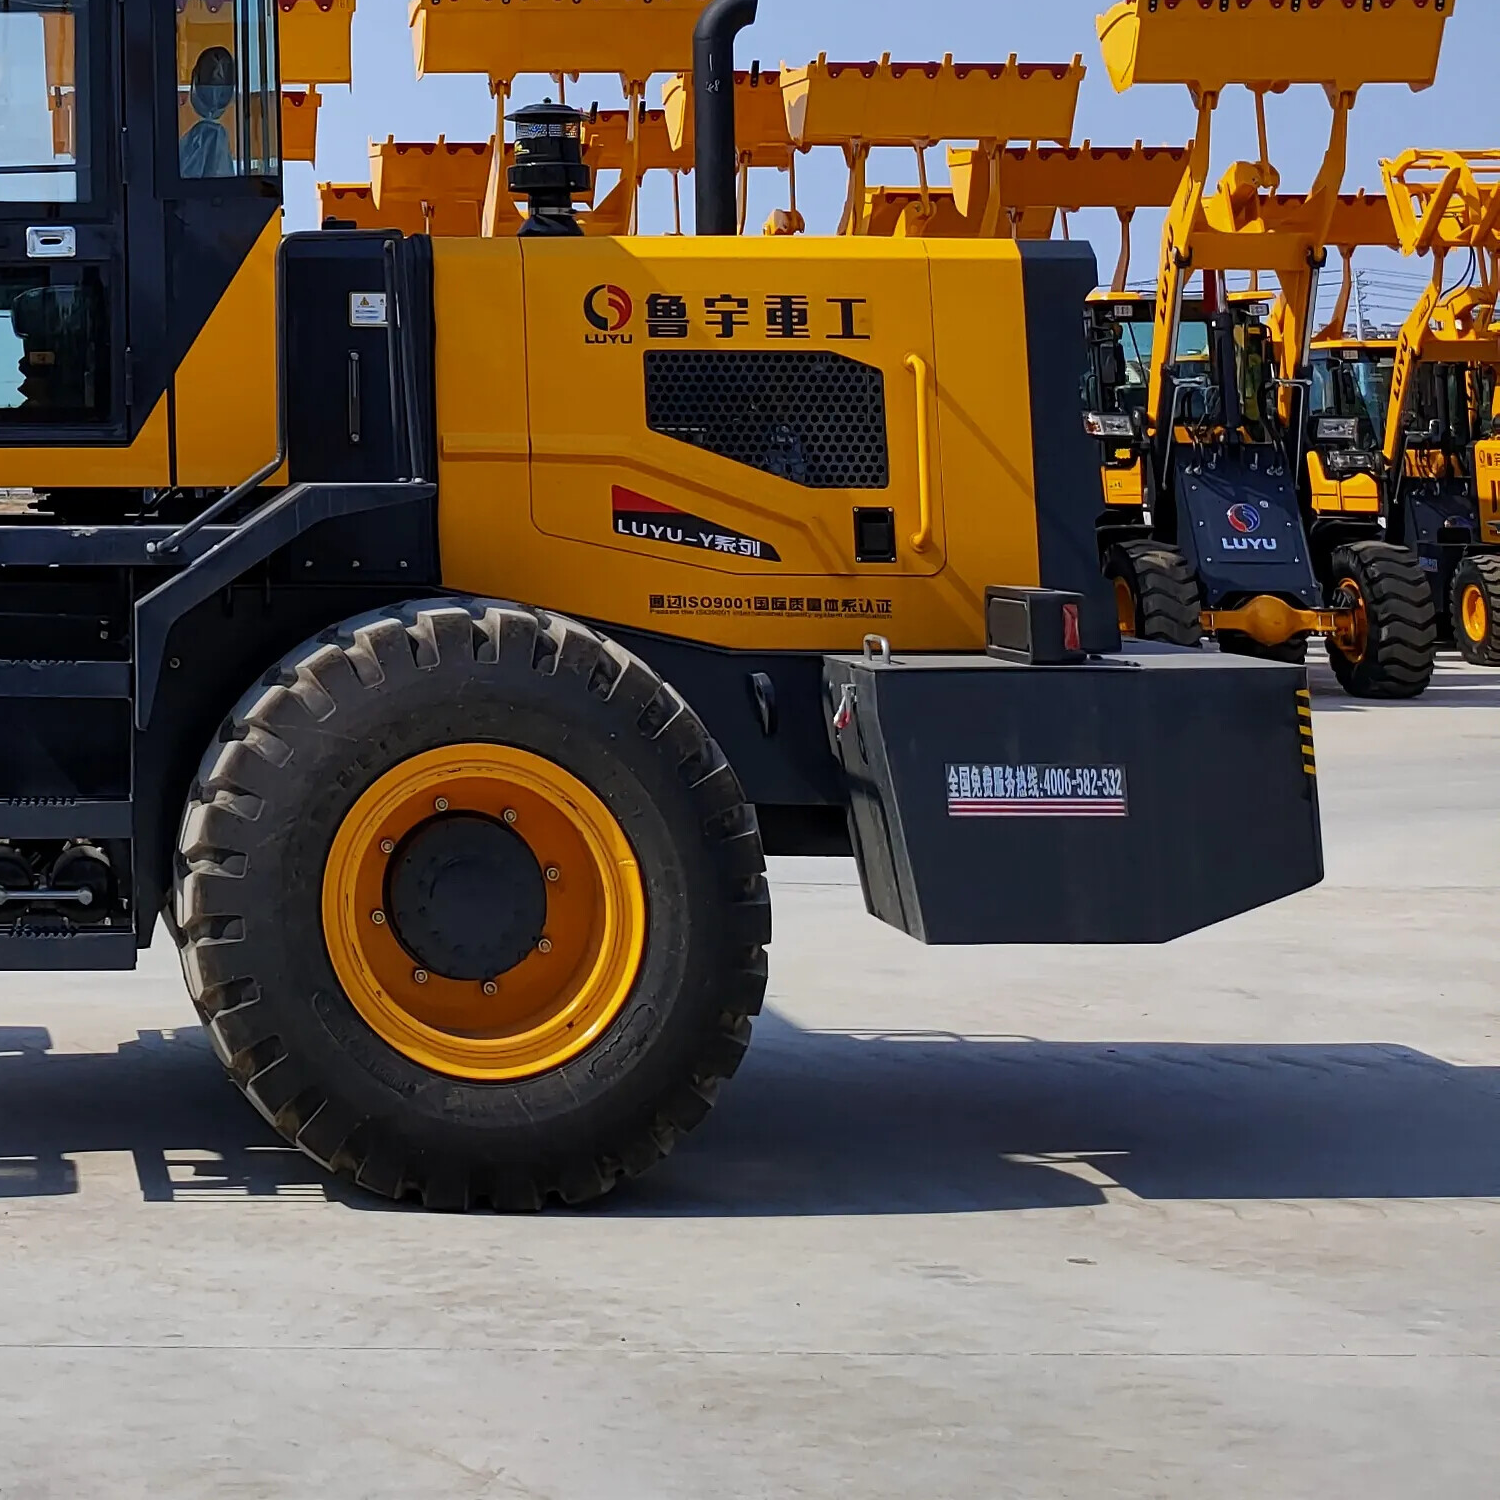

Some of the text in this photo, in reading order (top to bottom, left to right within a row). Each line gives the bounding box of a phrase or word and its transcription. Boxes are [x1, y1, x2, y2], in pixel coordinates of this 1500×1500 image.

[645, 293, 871, 340] 鲁宇重工
[584, 333, 633, 344] LUYU
[617, 519, 761, 557] LUYU-Y系列
[1221, 537, 1277, 550] LUYU
